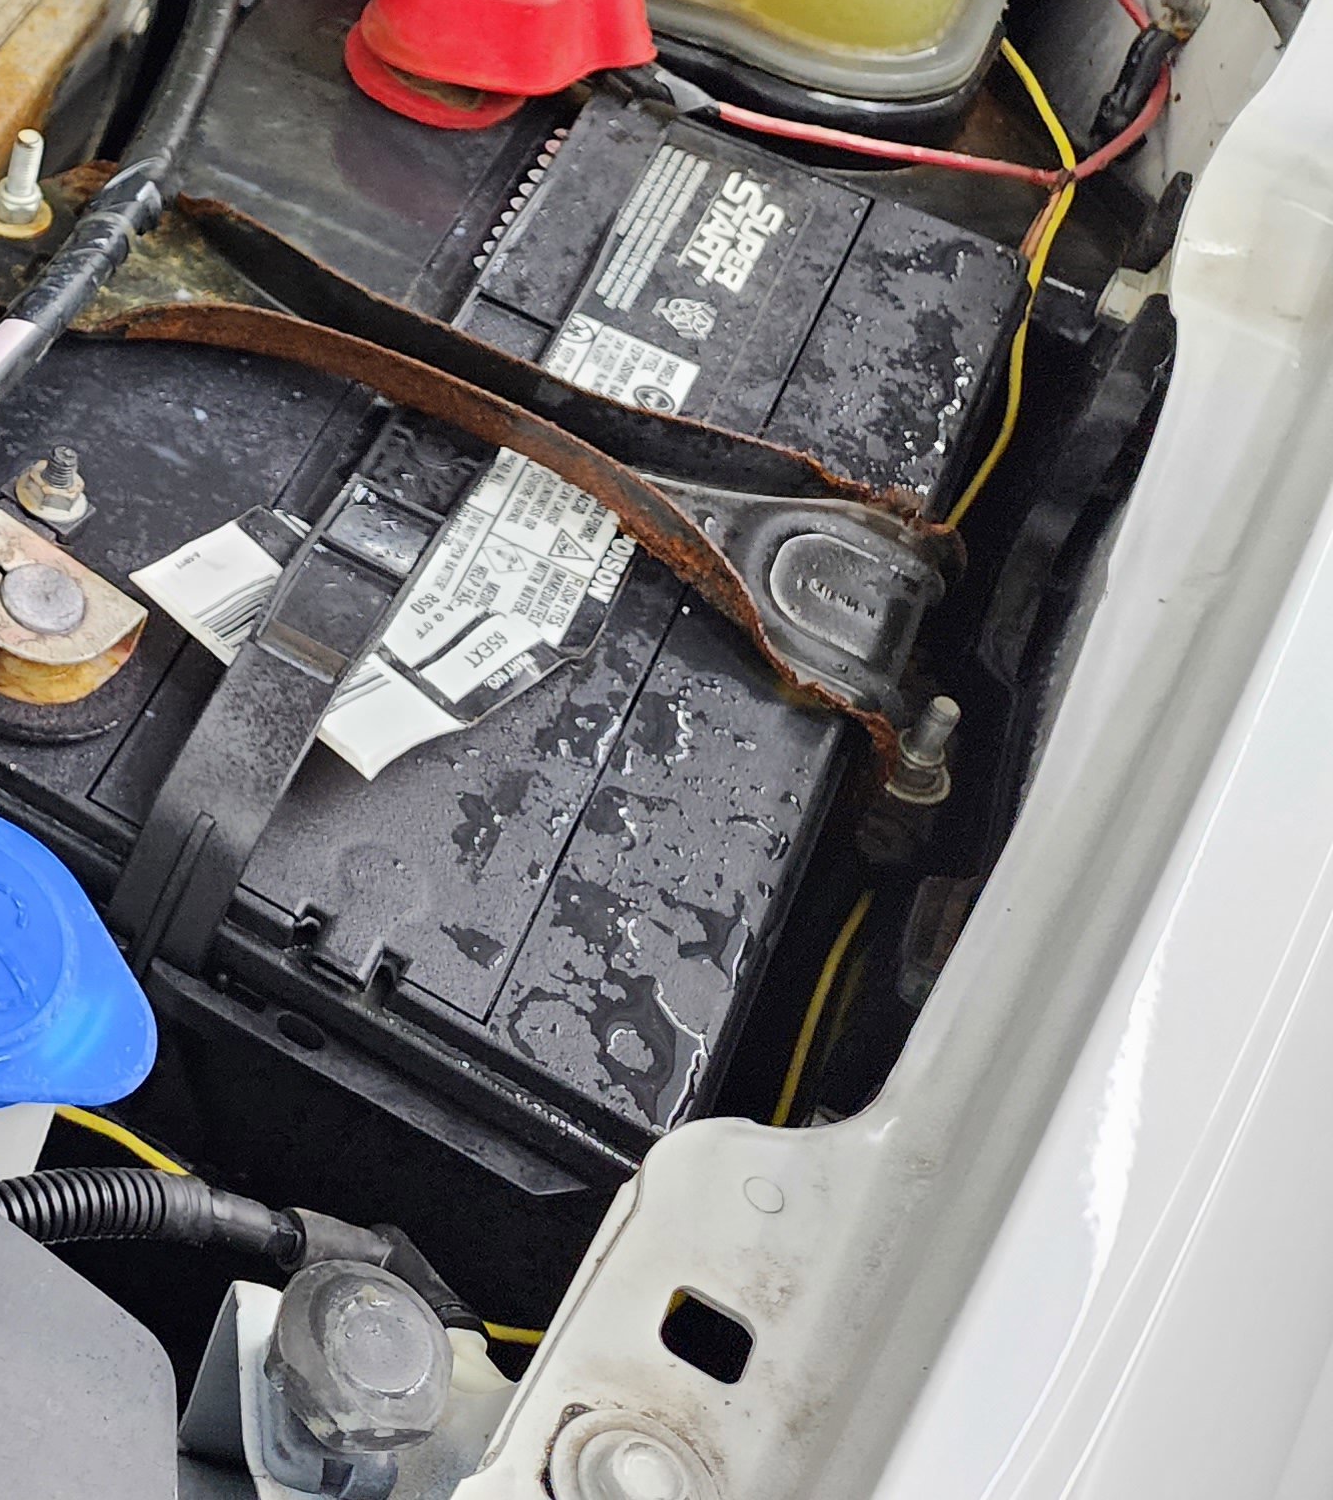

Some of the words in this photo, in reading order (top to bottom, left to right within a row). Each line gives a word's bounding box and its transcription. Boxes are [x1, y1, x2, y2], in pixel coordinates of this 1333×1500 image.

[686, 170, 763, 282] START
[714, 196, 786, 294] SUPER
[466, 562, 488, 587] HELP
[526, 559, 550, 585] WITH
[409, 592, 441, 615] 850
[525, 567, 566, 628] IMMEDIATELY
[557, 575, 583, 605] FLUSH
[463, 630, 509, 668] 65EXT
